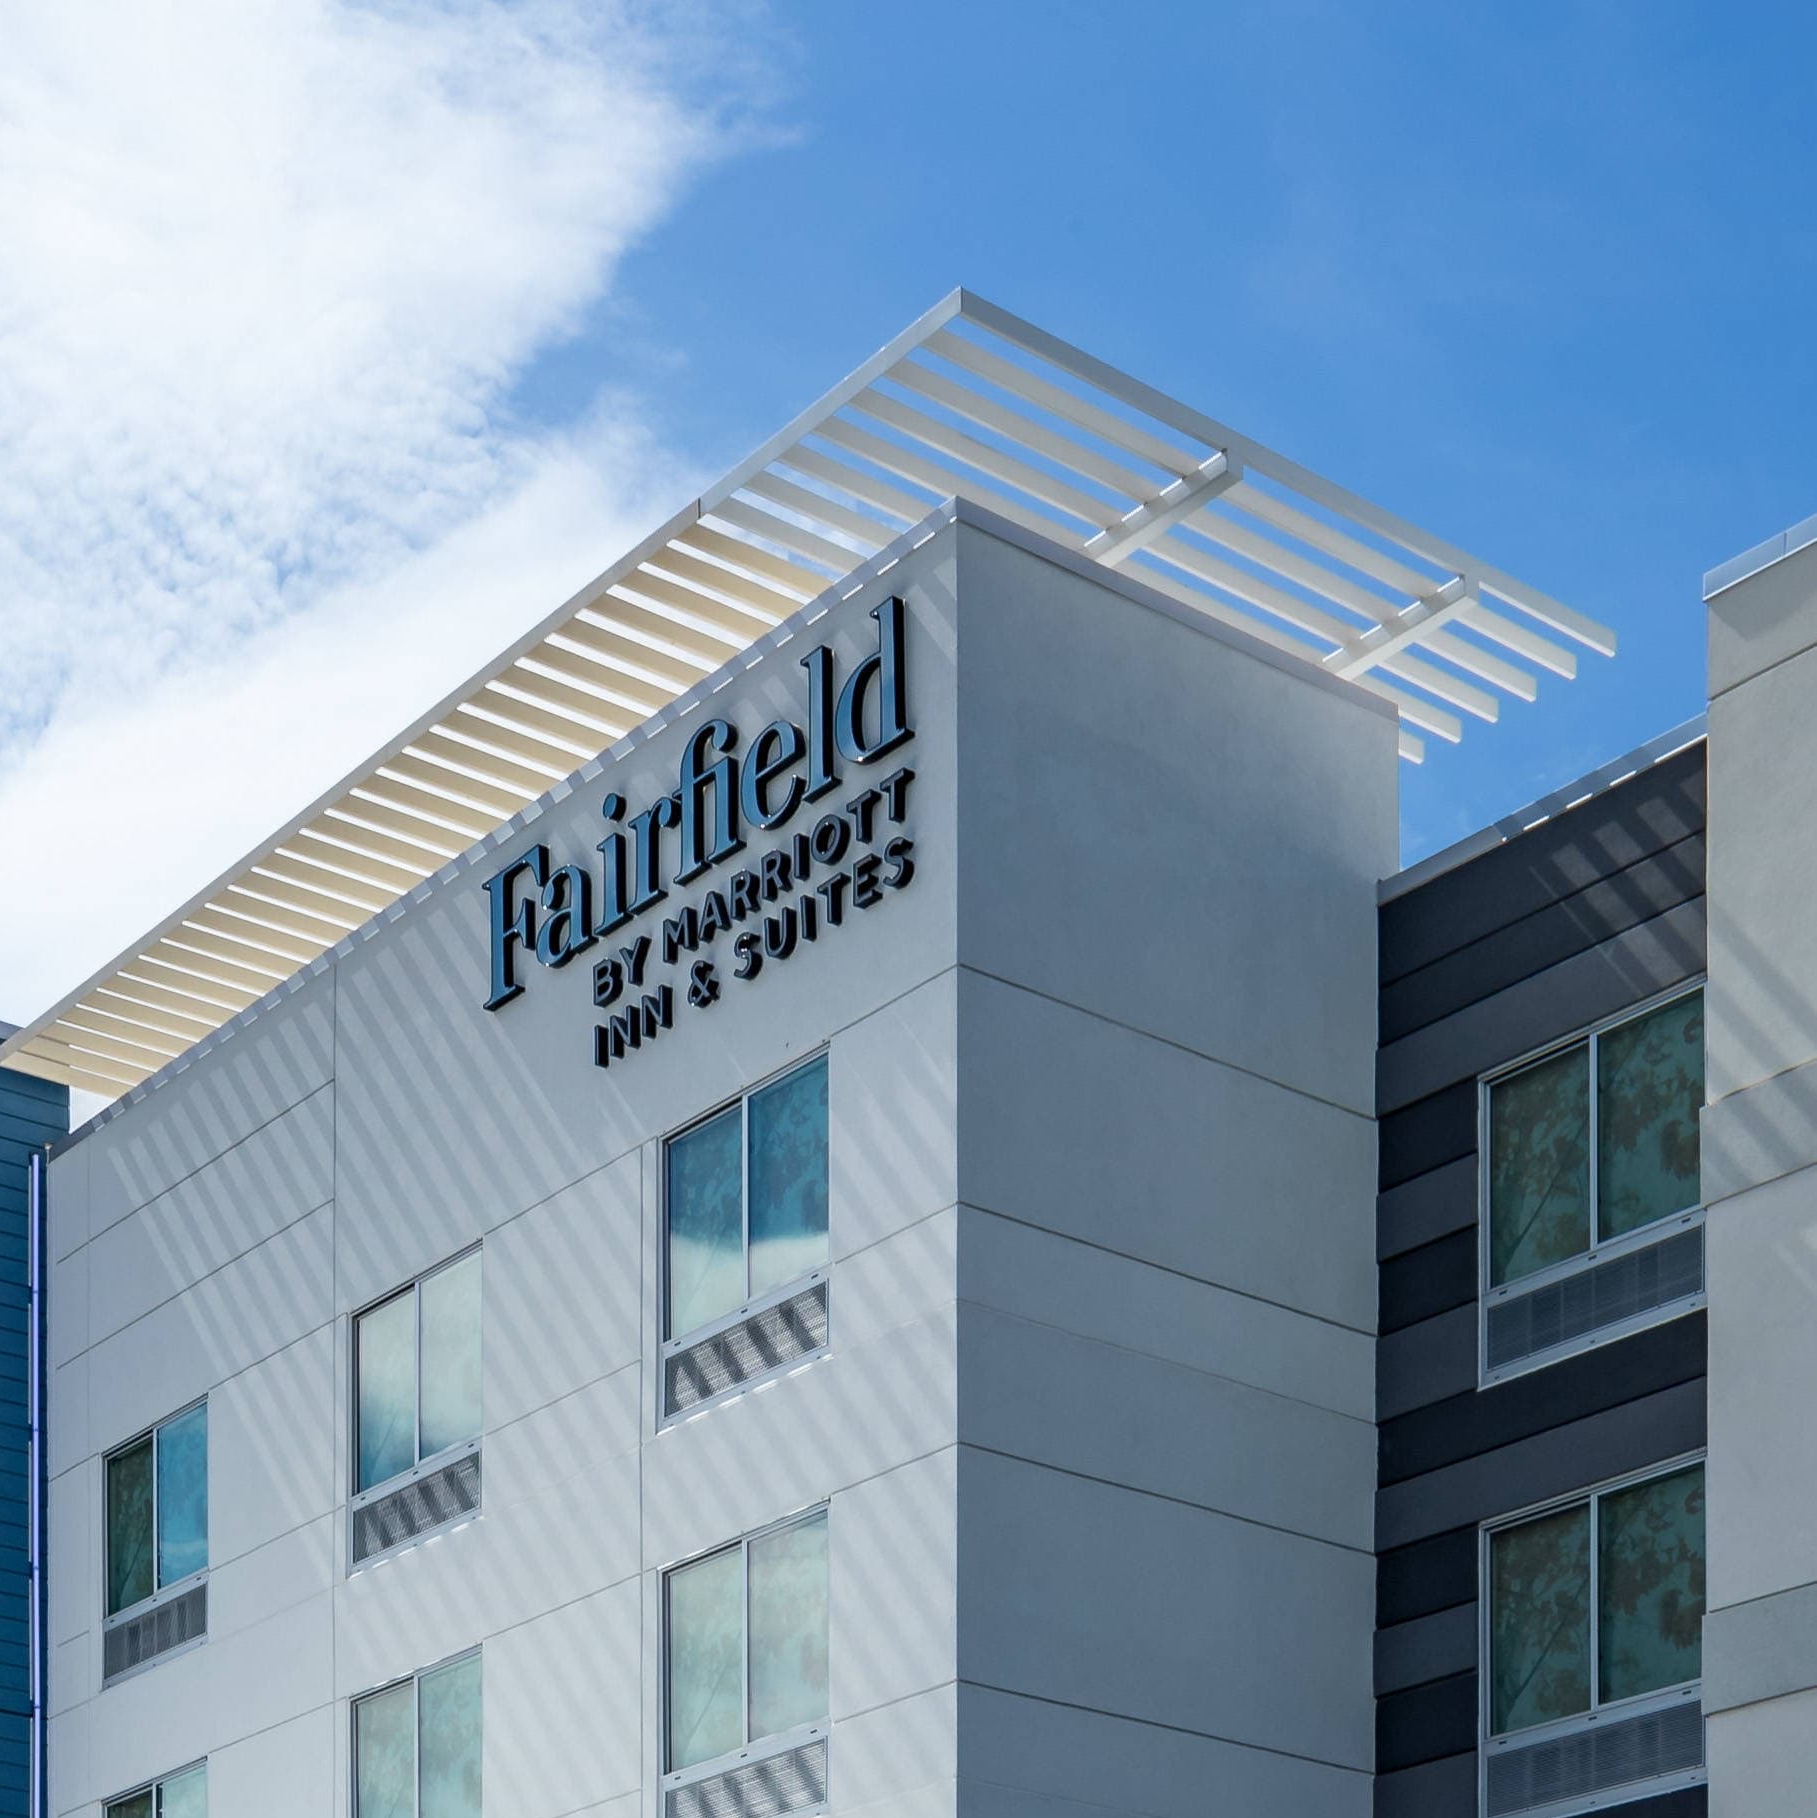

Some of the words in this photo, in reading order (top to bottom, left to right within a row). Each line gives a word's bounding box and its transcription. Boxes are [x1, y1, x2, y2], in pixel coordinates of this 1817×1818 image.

[482, 595, 916, 1012] Fairfield
[593, 935, 652, 1008] BY
[662, 766, 916, 965] MARRIOTT
[594, 984, 674, 1068] INN
[687, 959, 721, 1009] &
[733, 836, 914, 981] SUITES
